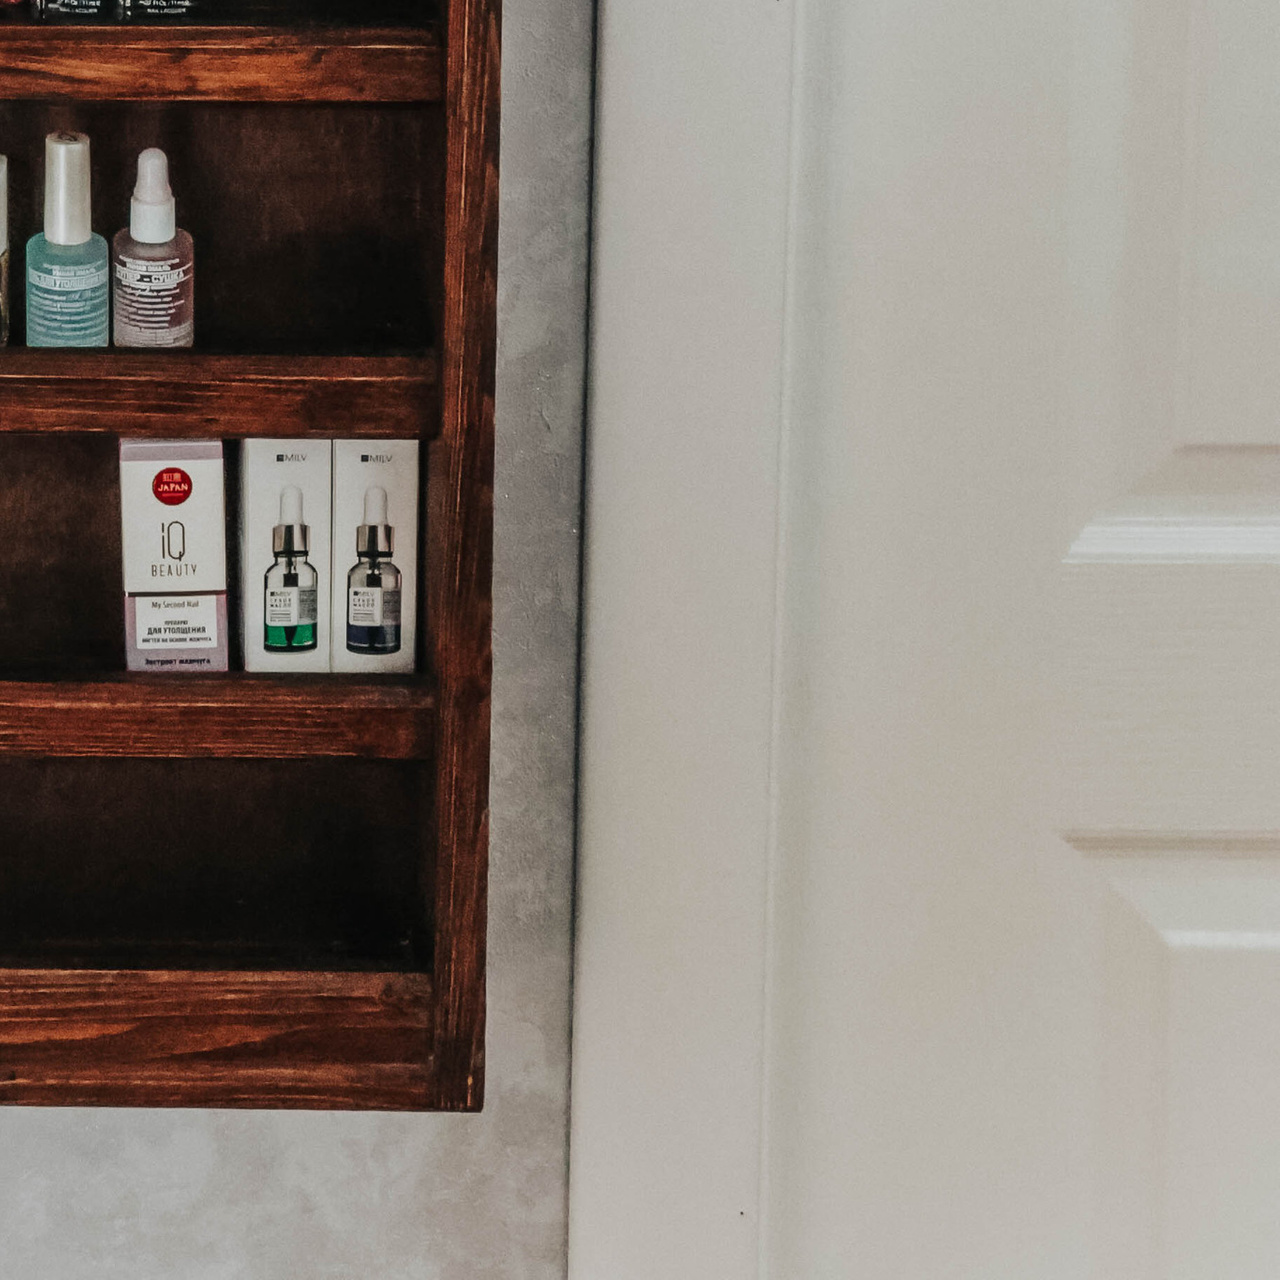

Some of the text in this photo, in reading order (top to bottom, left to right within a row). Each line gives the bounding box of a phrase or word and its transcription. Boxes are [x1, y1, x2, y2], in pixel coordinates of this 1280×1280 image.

[157, 483, 188, 492] JAPAN
[151, 564, 197, 577] BEAUTY
[163, 600, 186, 608] Second
[163, 626, 206, 634] УТОЛЩЕНИЯ
